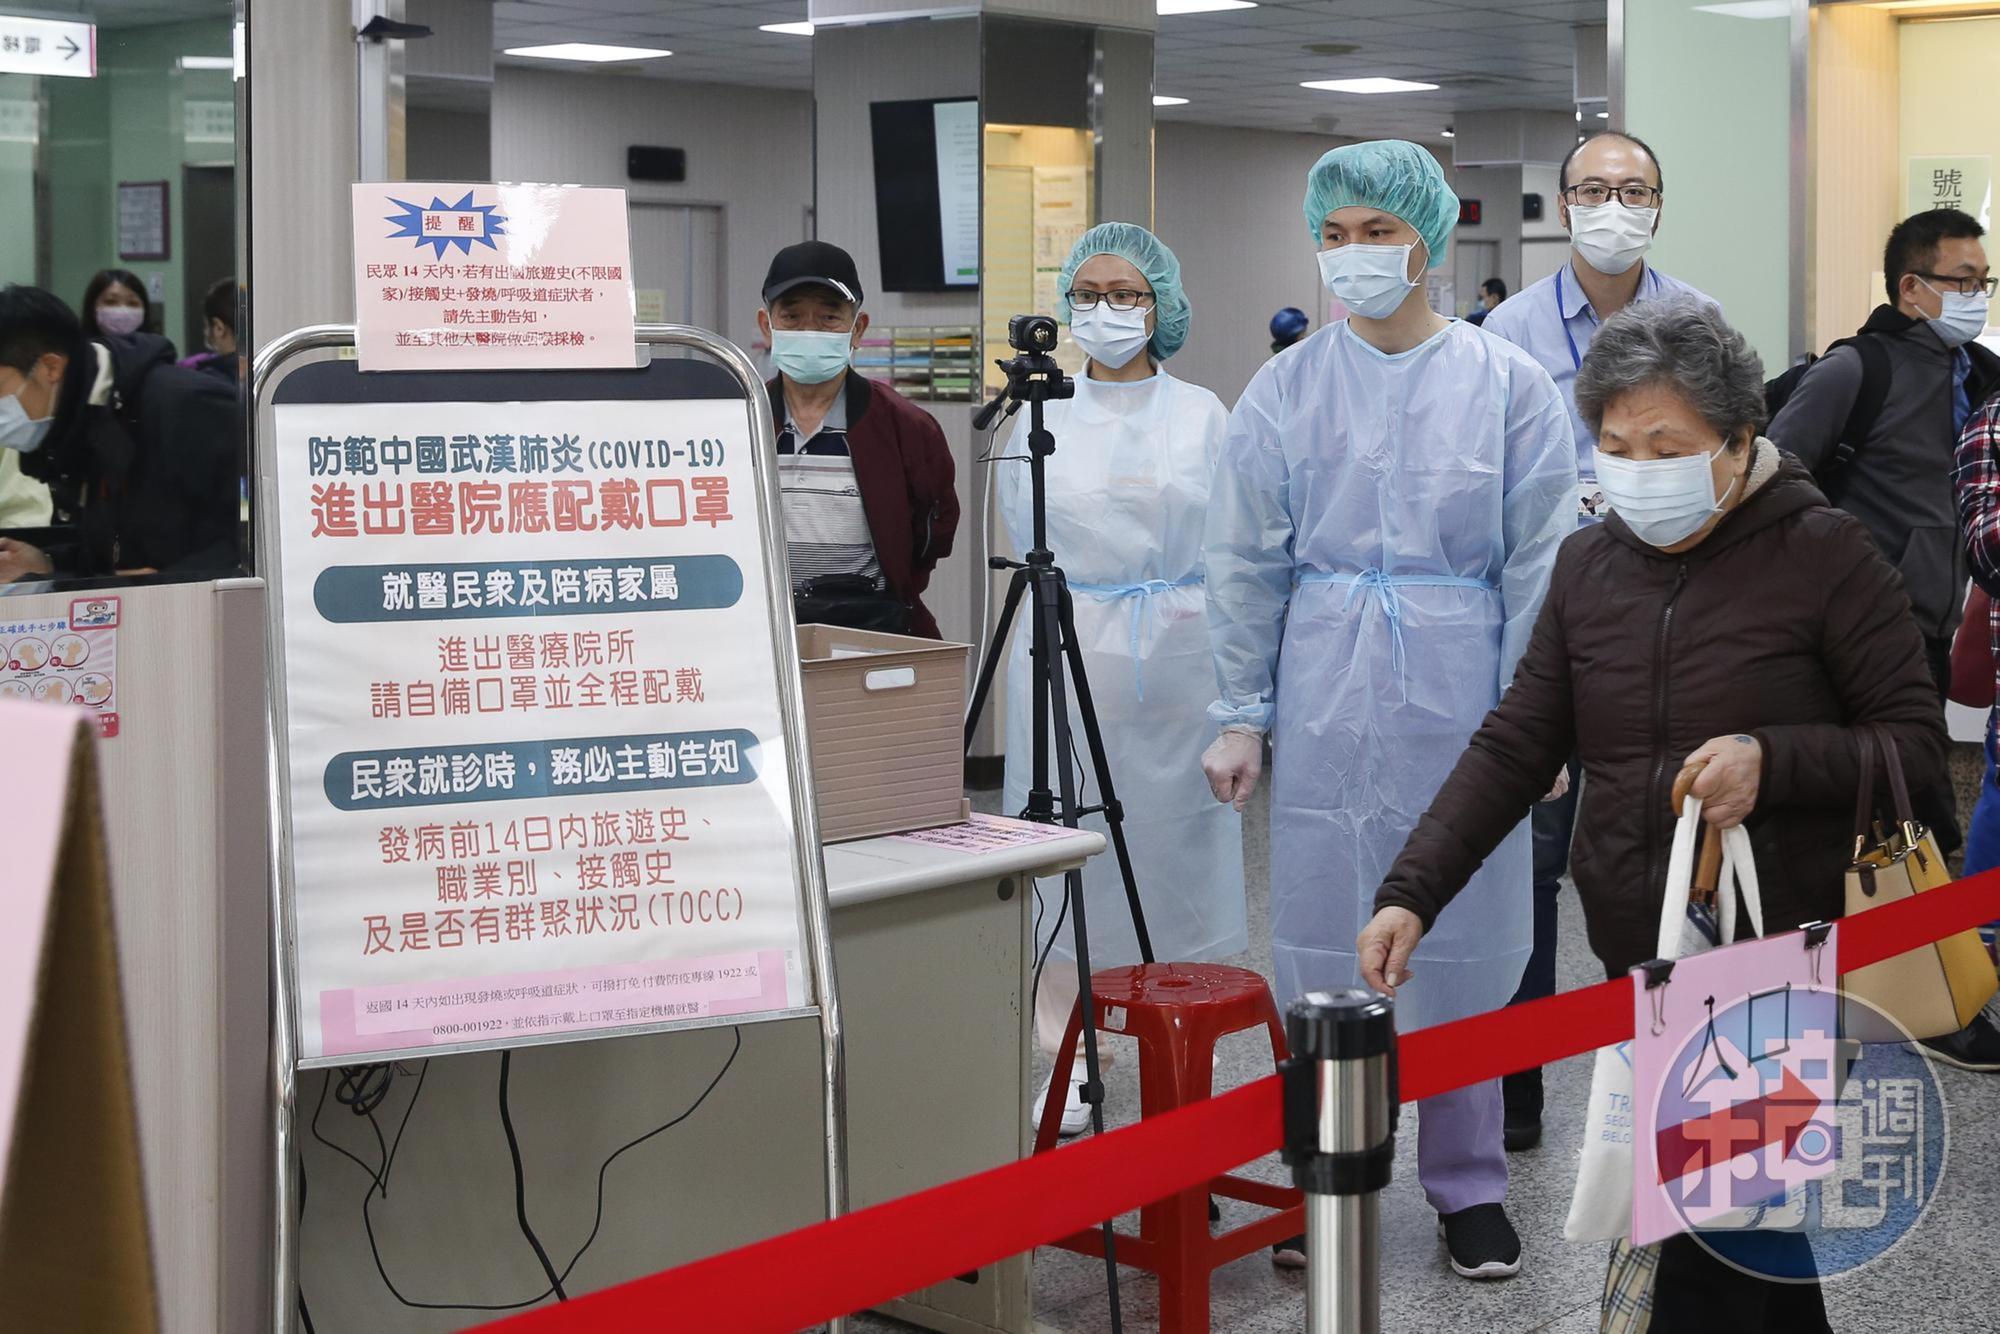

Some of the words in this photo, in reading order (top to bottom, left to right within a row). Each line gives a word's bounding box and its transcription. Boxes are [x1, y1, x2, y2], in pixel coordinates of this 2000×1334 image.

[403, 264, 419, 278] 14
[307, 432, 726, 477] 防範中國武漢肺炎(COVID-19)
[310, 475, 735, 539] 進出醫院應配戴口罩
[437, 628, 636, 674] 進出醫療院所
[369, 666, 705, 719] 請自備口罩並全程配戴
[435, 848, 676, 904] 職業別、接觸史
[361, 886, 745, 956] 及是否有群聚狀況(TOCC)
[396, 999, 409, 1010] 14
[717, 967, 742, 980] 1922
[1681, 980, 1791, 1099] 入口
